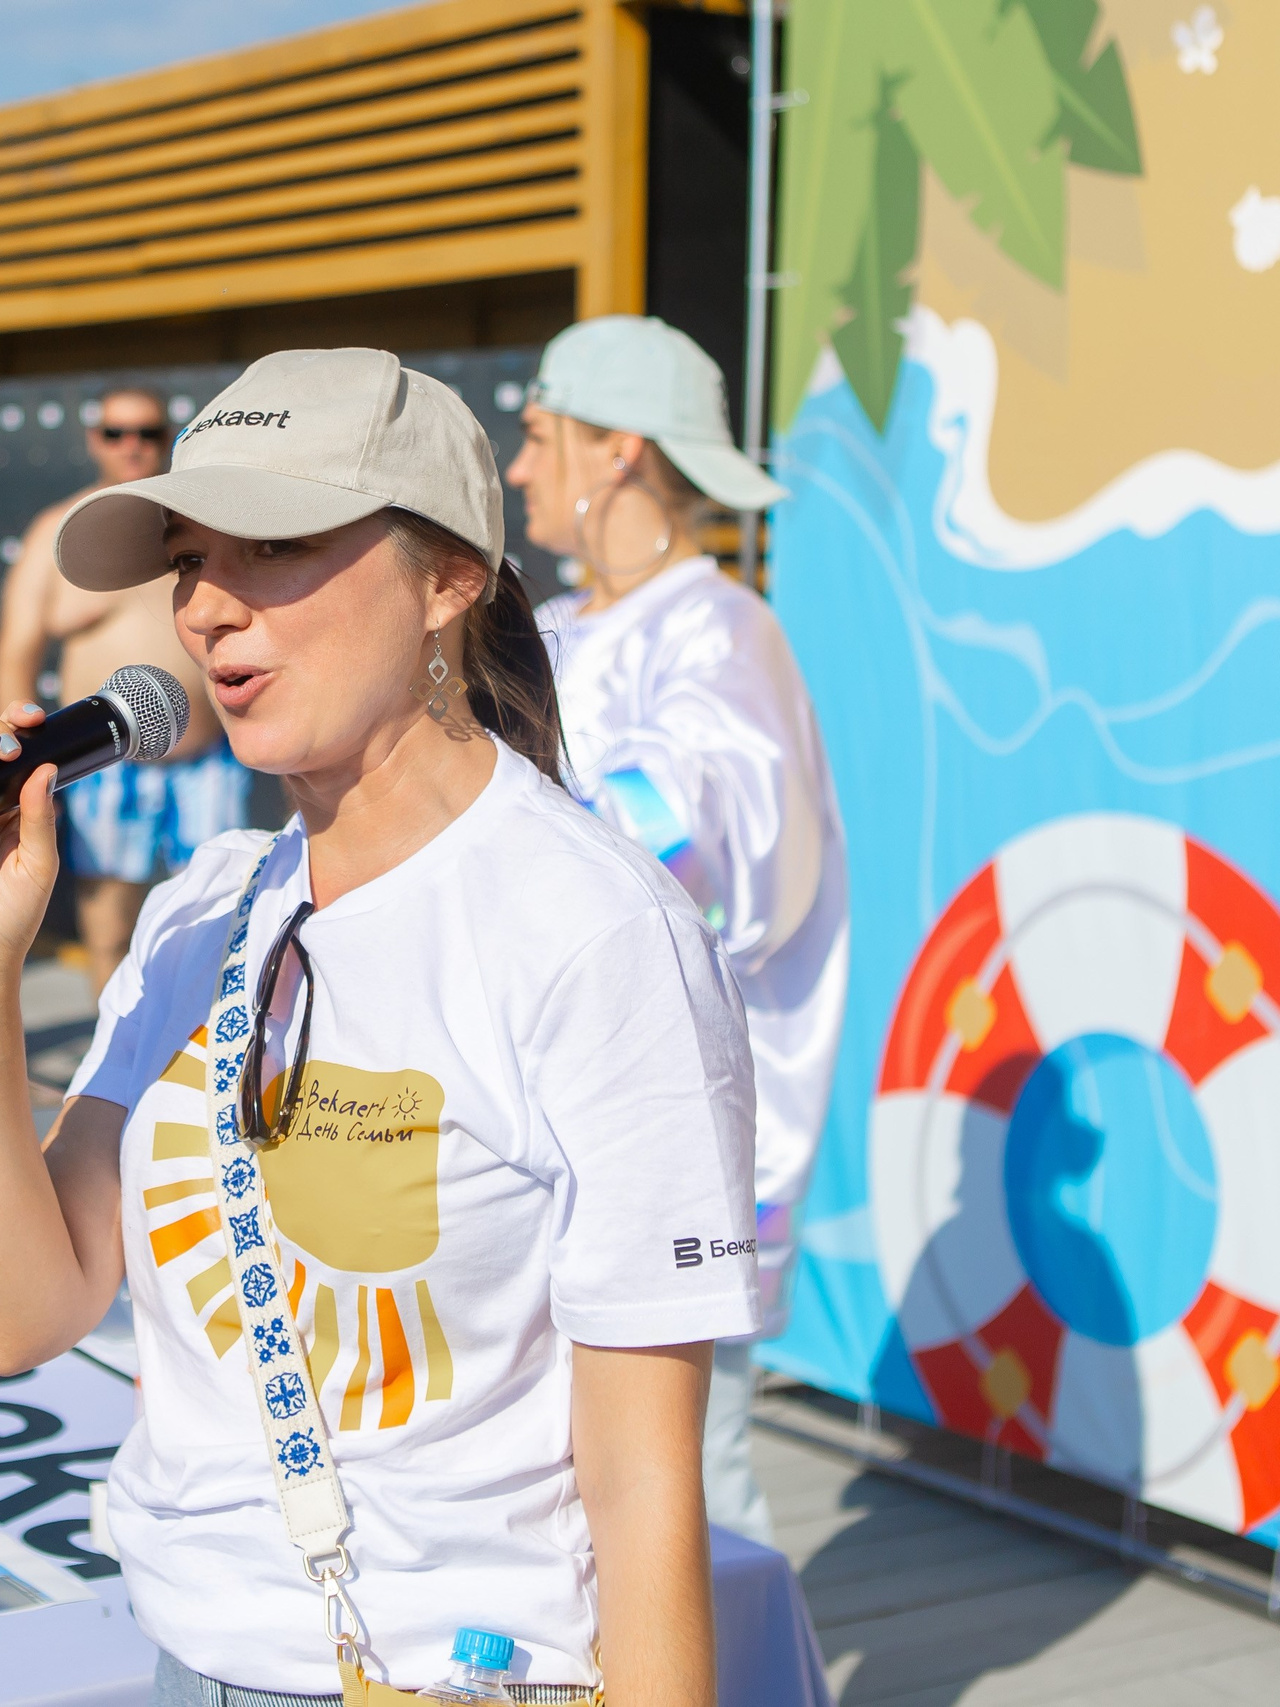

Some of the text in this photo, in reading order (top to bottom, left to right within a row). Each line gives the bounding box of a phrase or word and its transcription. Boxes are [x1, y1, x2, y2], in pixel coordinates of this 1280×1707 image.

[107, 720, 121, 756] SHURE
[306, 1079, 389, 1119] Bekaert
[296, 1112, 339, 1142] День
